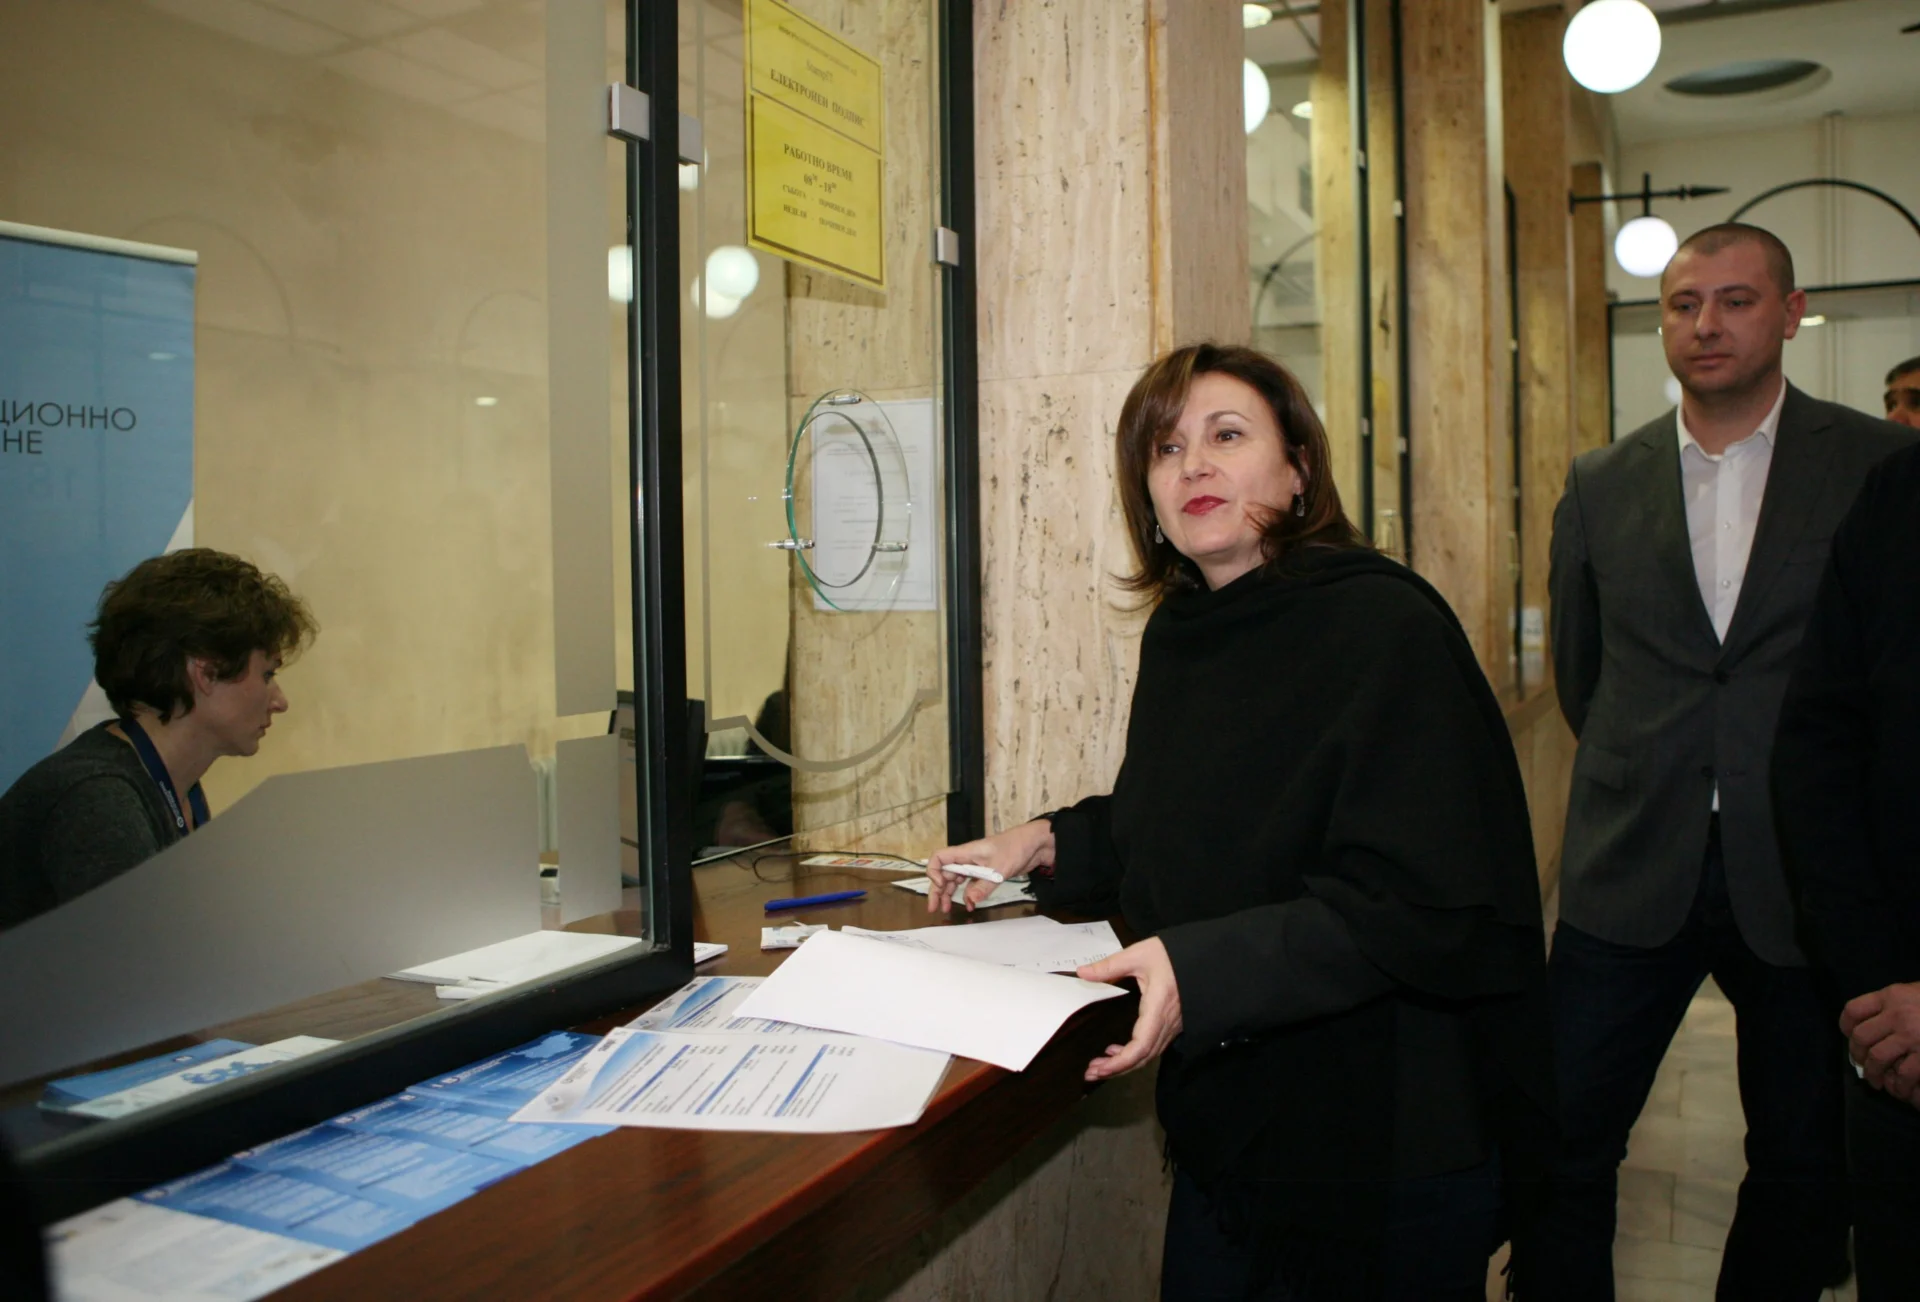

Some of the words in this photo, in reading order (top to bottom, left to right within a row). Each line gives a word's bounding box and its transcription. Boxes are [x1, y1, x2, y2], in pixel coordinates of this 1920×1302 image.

[770, 68, 828, 109] ЕЛЕКТРОНЕН
[784, 143, 825, 170] РАБОТНО
[3, 429, 43, 454] НЕ
